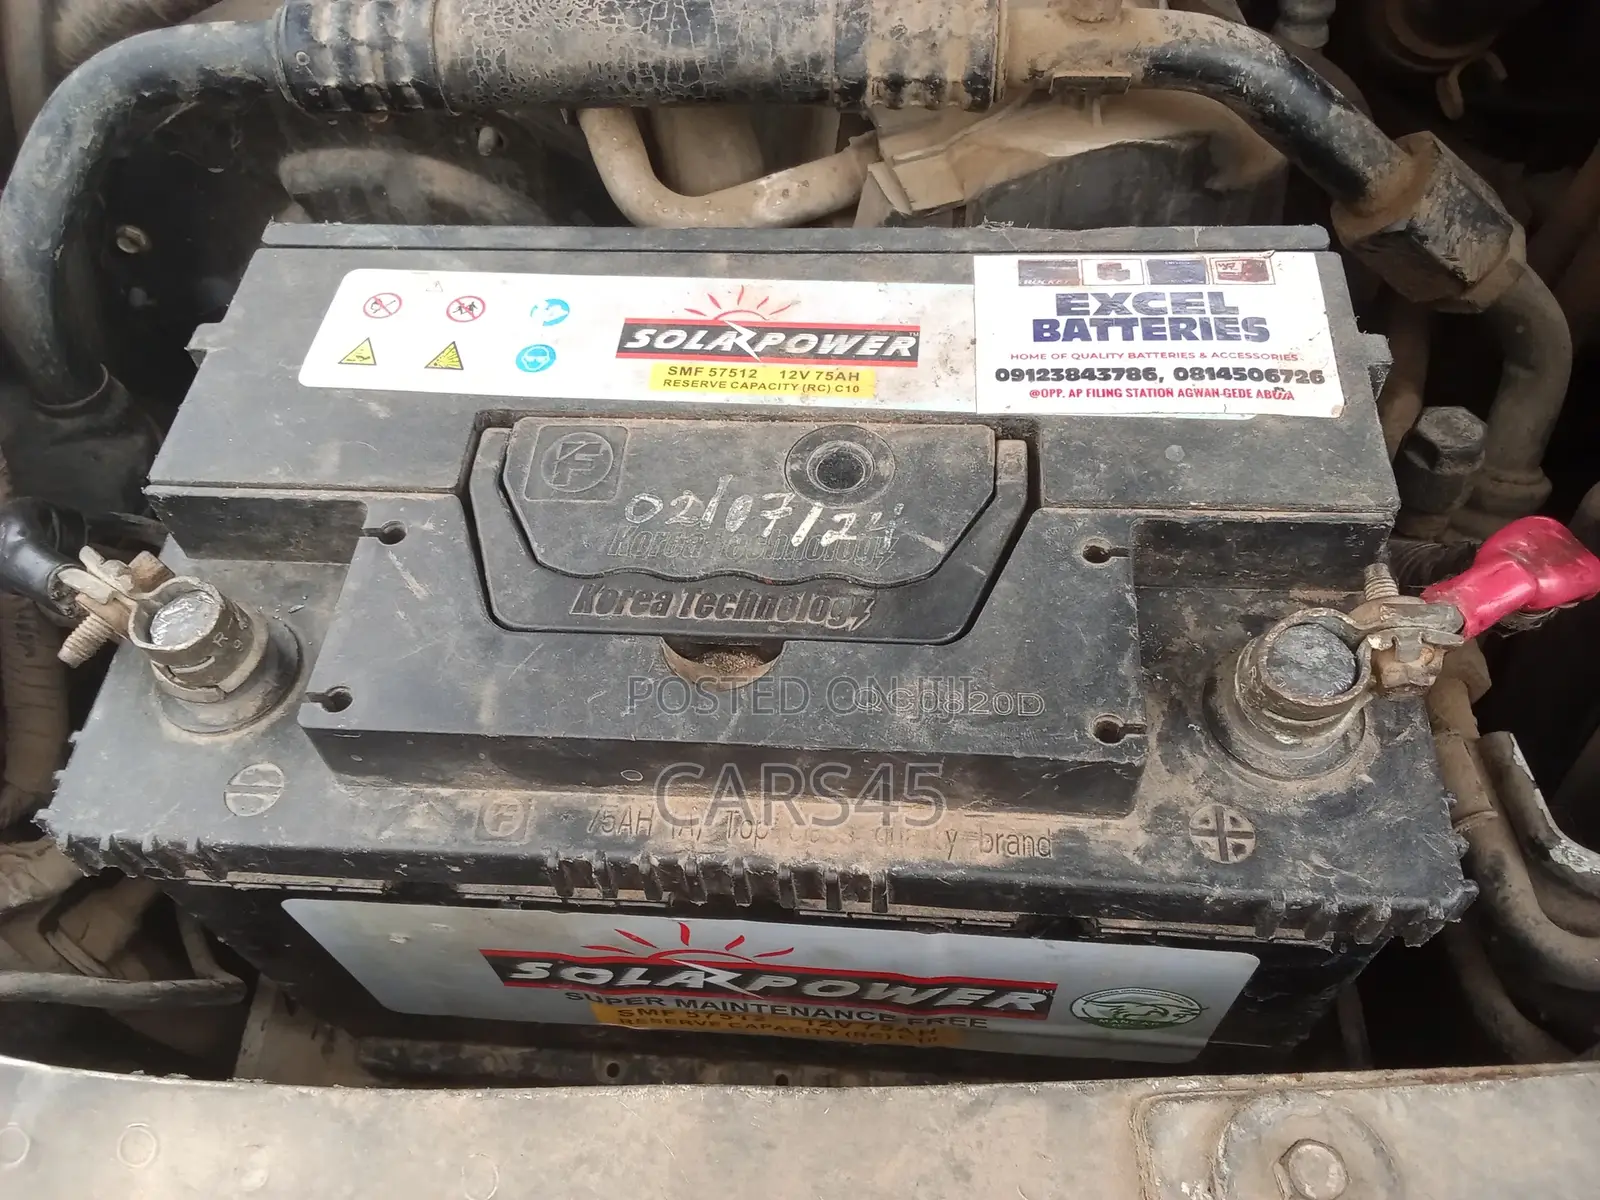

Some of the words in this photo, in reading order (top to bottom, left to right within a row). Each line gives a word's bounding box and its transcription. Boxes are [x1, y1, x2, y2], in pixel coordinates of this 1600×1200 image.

[1056, 292, 1239, 316] EXCEL
[1033, 317, 1270, 342] BATTERIES
[1010, 353, 1047, 361] HOME
[1051, 353, 1068, 361] OF
[1072, 352, 1124, 361] QUALITY
[1128, 351, 1196, 360] BATTERIES
[1211, 351, 1299, 362] ACCESSORIES
[668, 366, 703, 377] SMF
[708, 368, 757, 379] 57512
[780, 370, 810, 380] 12V
[815, 371, 860, 381] 75AH
[995, 367, 1164, 383] 09123843786,
[1173, 367, 1326, 385] 0814506726
[663, 379, 726, 389] RESERVE
[731, 381, 800, 392] CAPACITY
[802, 383, 831, 393] (RC)
[835, 384, 859, 393] C10
[1029, 388, 1065, 399] @OPP.
[1068, 388, 1083, 398] AP
[1086, 388, 1122, 398] FILING
[1125, 387, 1174, 398] STATION
[569, 585, 671, 619] Korea
[977, 825, 1053, 858] brand
[565, 991, 668, 1007] SUPER
[676, 998, 897, 1023] MAINTENANCE
[908, 1016, 988, 1029] FREE
[620, 1017, 721, 1028] RESERVE
[728, 1021, 838, 1036] CAPACITY
